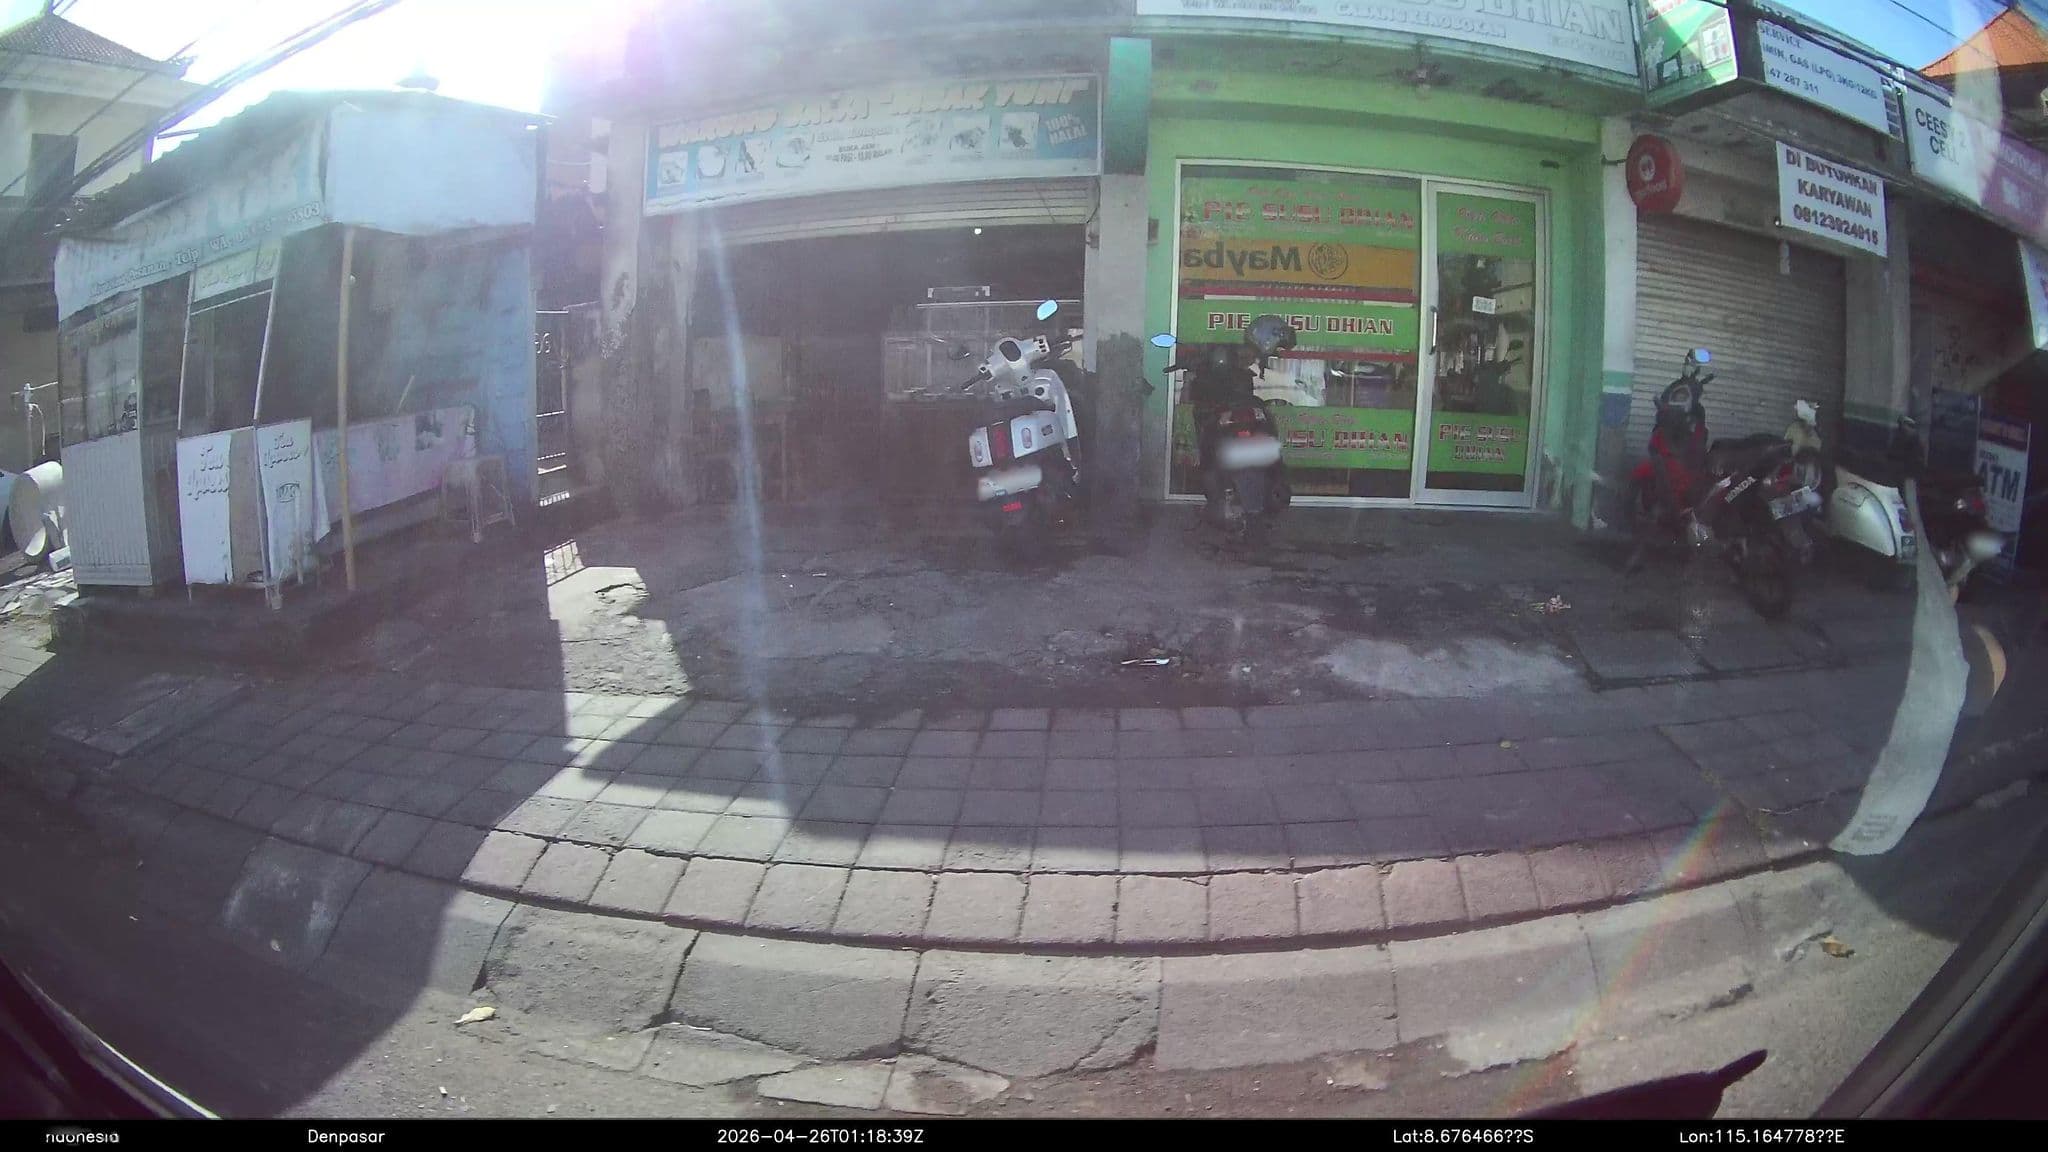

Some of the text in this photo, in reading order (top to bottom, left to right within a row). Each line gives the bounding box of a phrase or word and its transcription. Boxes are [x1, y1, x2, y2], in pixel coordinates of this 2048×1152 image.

[1786, 149, 1878, 196] DI BUTUHKAN
[1797, 178, 1873, 219] KARYAWAN
[1202, 200, 1415, 230] PIE SUSU DHIAN
[1207, 311, 1251, 331] PIE
[1325, 315, 1394, 336] DHIAN
[1333, 430, 1409, 452] DHIAN
[1439, 423, 1473, 441] PIE
[1724, 476, 1757, 503] HONDA
[1979, 460, 2021, 504] ATM
